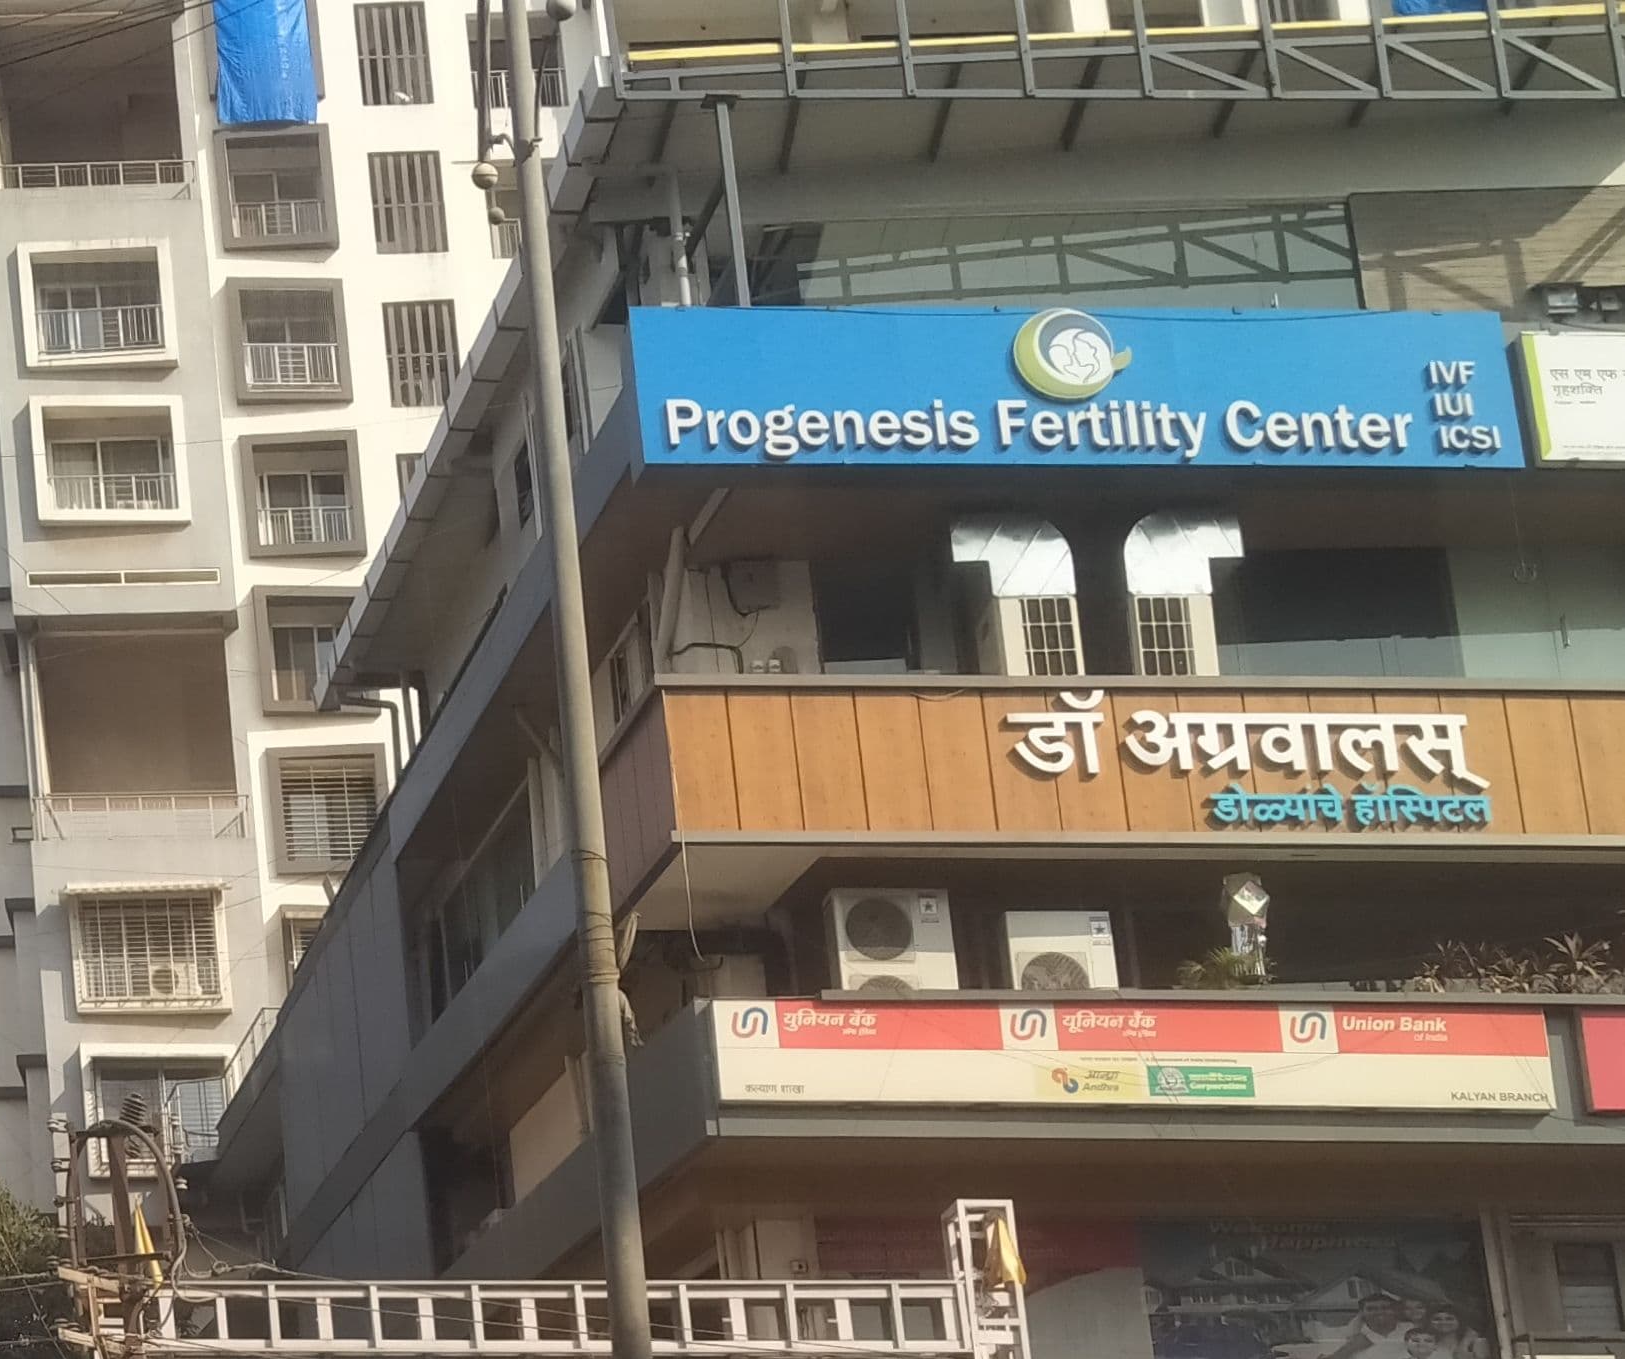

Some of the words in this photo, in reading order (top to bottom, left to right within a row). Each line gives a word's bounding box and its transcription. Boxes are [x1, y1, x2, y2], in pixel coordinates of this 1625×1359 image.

[1428, 360, 1475, 388] IVF
[1550, 368, 1569, 380] एस
[1432, 391, 1474, 420] IUI
[665, 399, 980, 458] Progenesis
[998, 399, 1207, 460] Fertility
[1224, 400, 1414, 452] Center
[1439, 424, 1502, 452] ICSI
[1007, 691, 1105, 775] डॉ
[1350, 782, 1492, 824] हॉस्पिटल
[1342, 1016, 1395, 1031] Union
[1400, 1016, 1447, 1032] Bank
[1426, 1033, 1448, 1042] India
[1451, 1091, 1496, 1101] KALYAN
[1499, 1092, 1549, 1103] BRANCH
